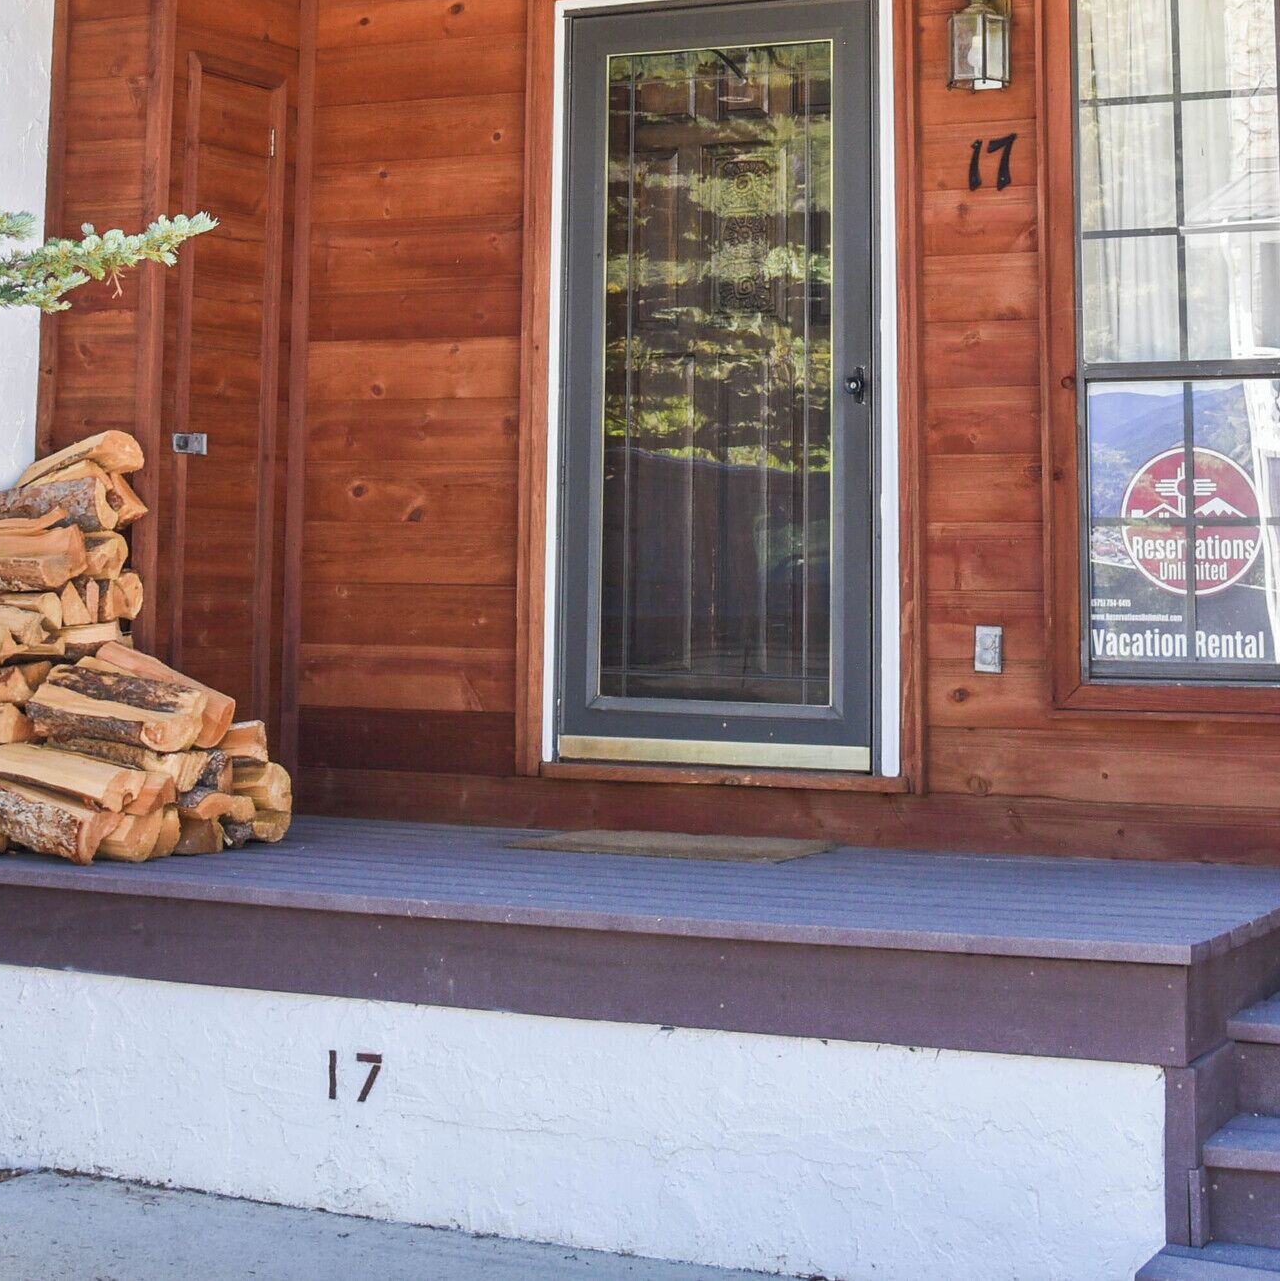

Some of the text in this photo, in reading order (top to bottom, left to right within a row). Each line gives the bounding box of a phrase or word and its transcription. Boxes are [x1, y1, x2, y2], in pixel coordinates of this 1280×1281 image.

[969, 133, 1017, 191] 17
[1132, 535, 1255, 560] Reserations
[1092, 628, 1265, 658] Vacation Rental
[329, 1050, 383, 1102] 17
